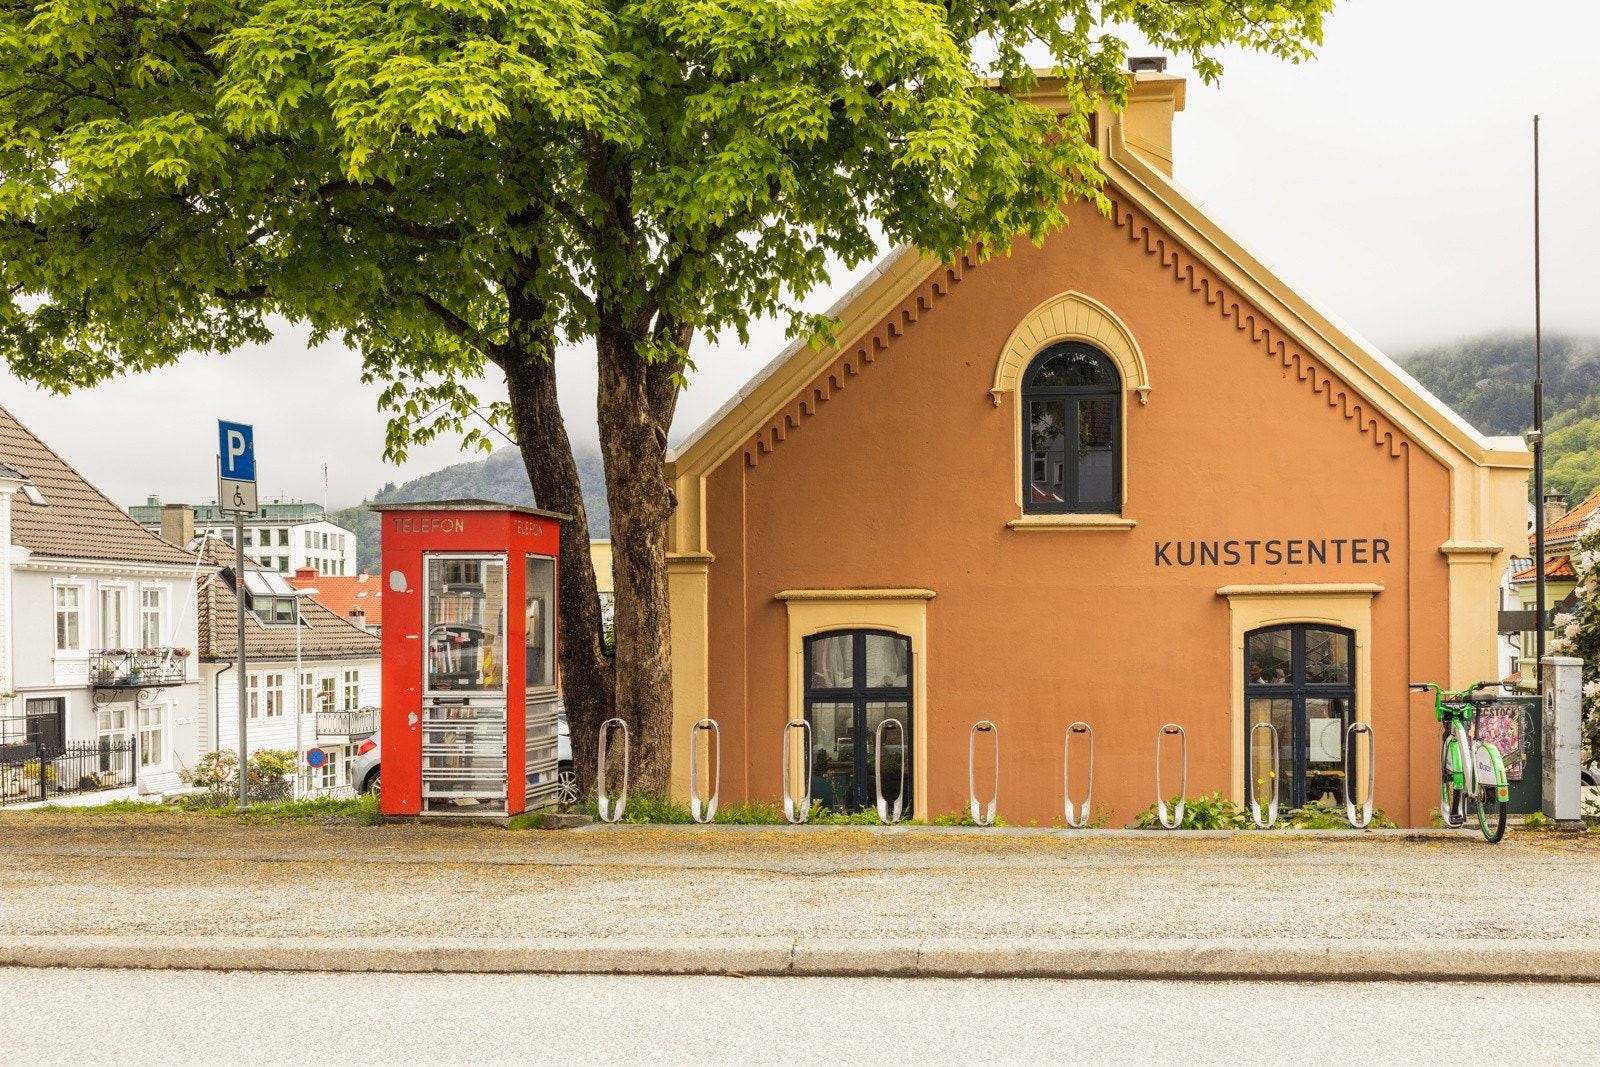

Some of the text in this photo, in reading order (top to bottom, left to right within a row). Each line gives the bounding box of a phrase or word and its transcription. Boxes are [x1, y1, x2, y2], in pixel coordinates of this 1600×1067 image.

[227, 429, 246, 472] P
[393, 518, 464, 533] TELEFON
[513, 519, 544, 536] TELEFON
[1154, 538, 1392, 567] KUNSTSENTER
